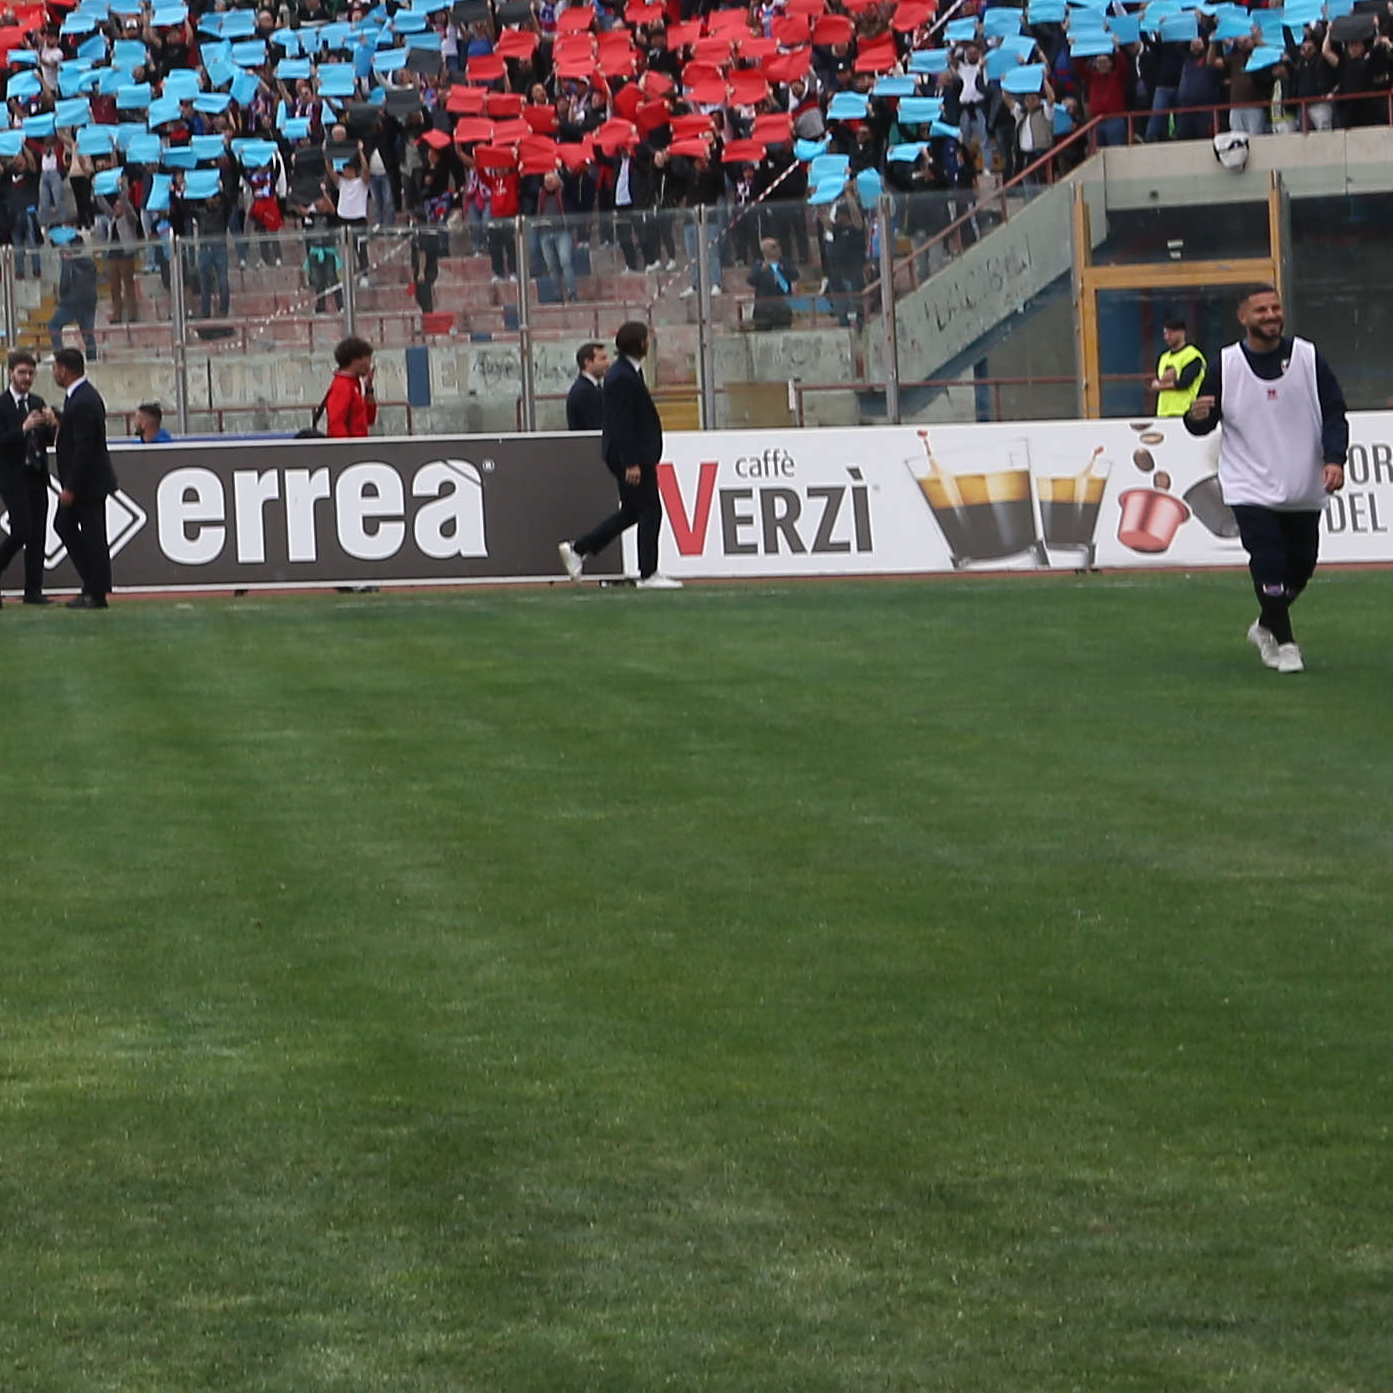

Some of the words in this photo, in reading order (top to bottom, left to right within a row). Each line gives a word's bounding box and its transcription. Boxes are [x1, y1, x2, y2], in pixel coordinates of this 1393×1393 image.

[735, 449, 795, 477] caffè
[655, 462, 873, 556] VERZÌ
[1326, 492, 1389, 534] DEL
